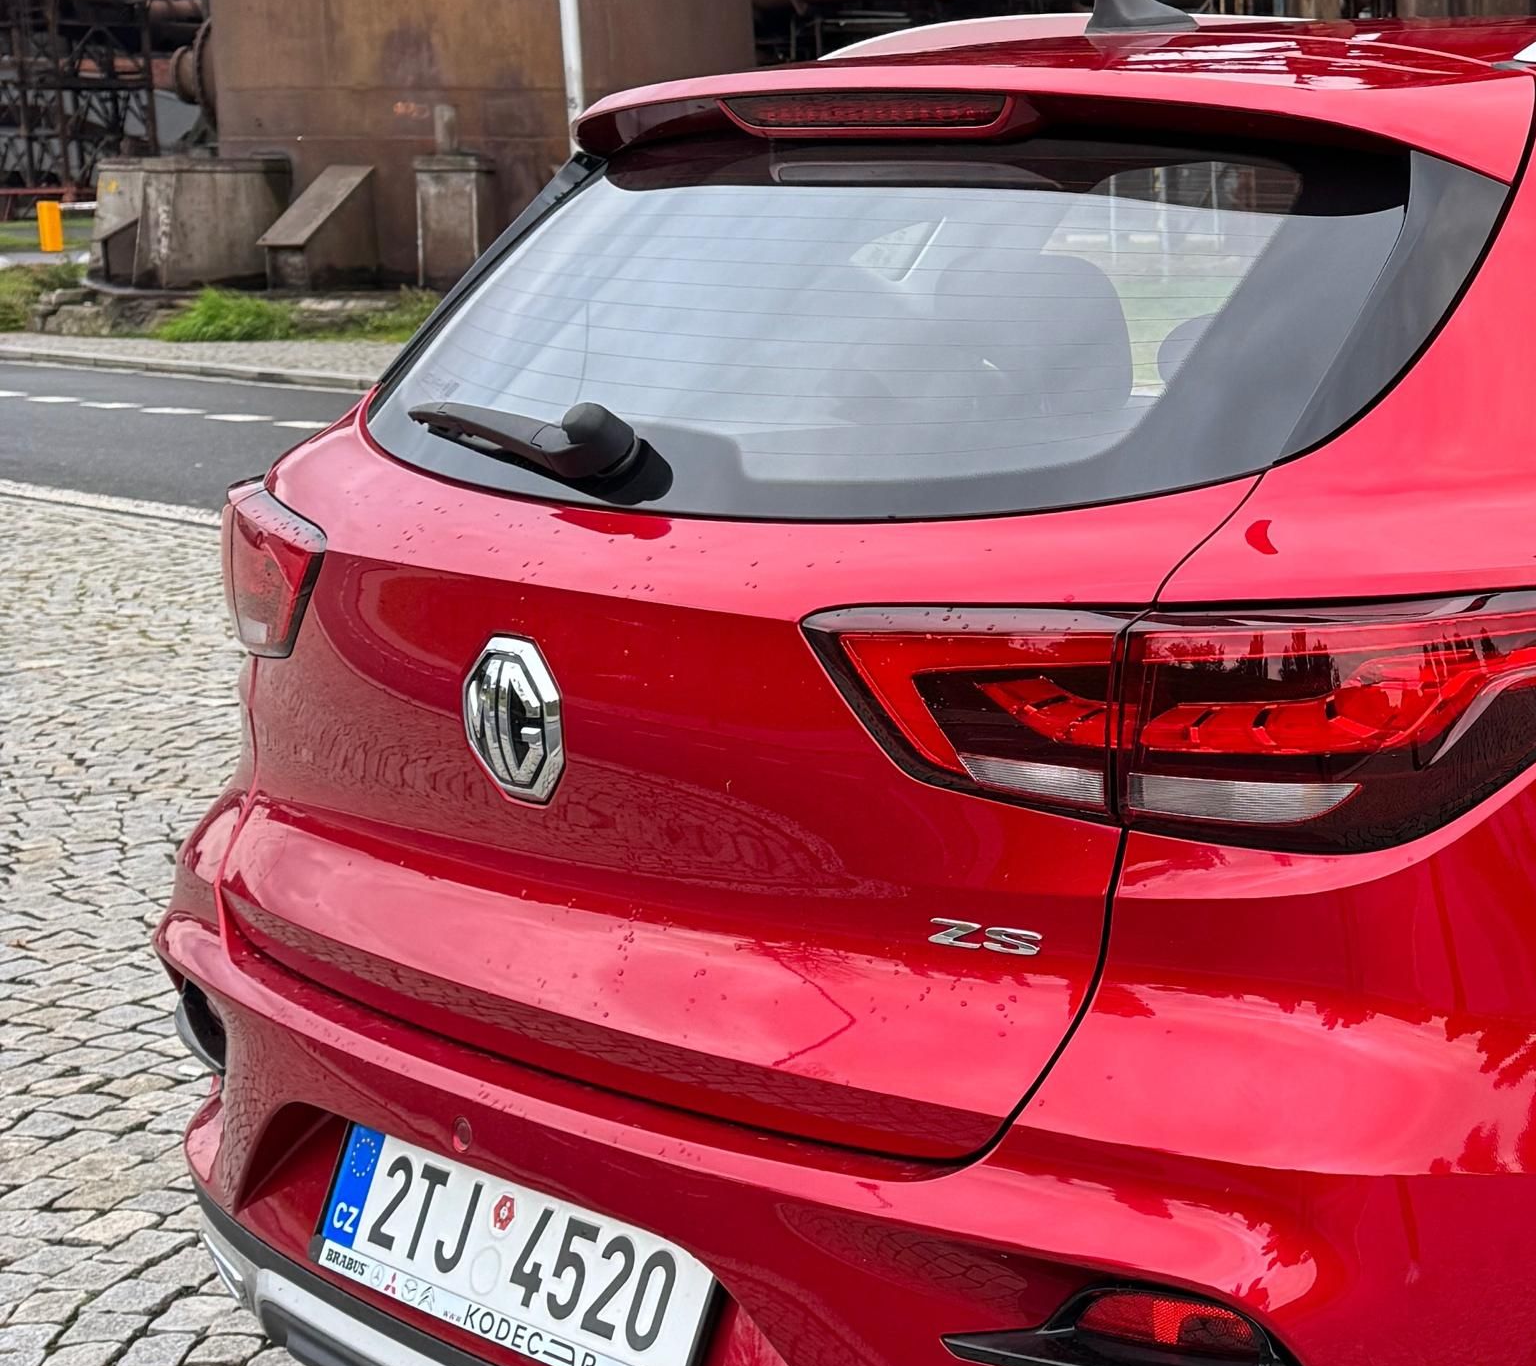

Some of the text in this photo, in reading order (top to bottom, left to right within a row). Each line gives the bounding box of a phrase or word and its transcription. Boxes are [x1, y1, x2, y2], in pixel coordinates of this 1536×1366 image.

[467, 650, 549, 787] MG
[928, 917, 1043, 956] ZS
[332, 1201, 360, 1234] CZ
[325, 1248, 368, 1277] BRABUS
[366, 1155, 678, 1353] 2TJ 4520
